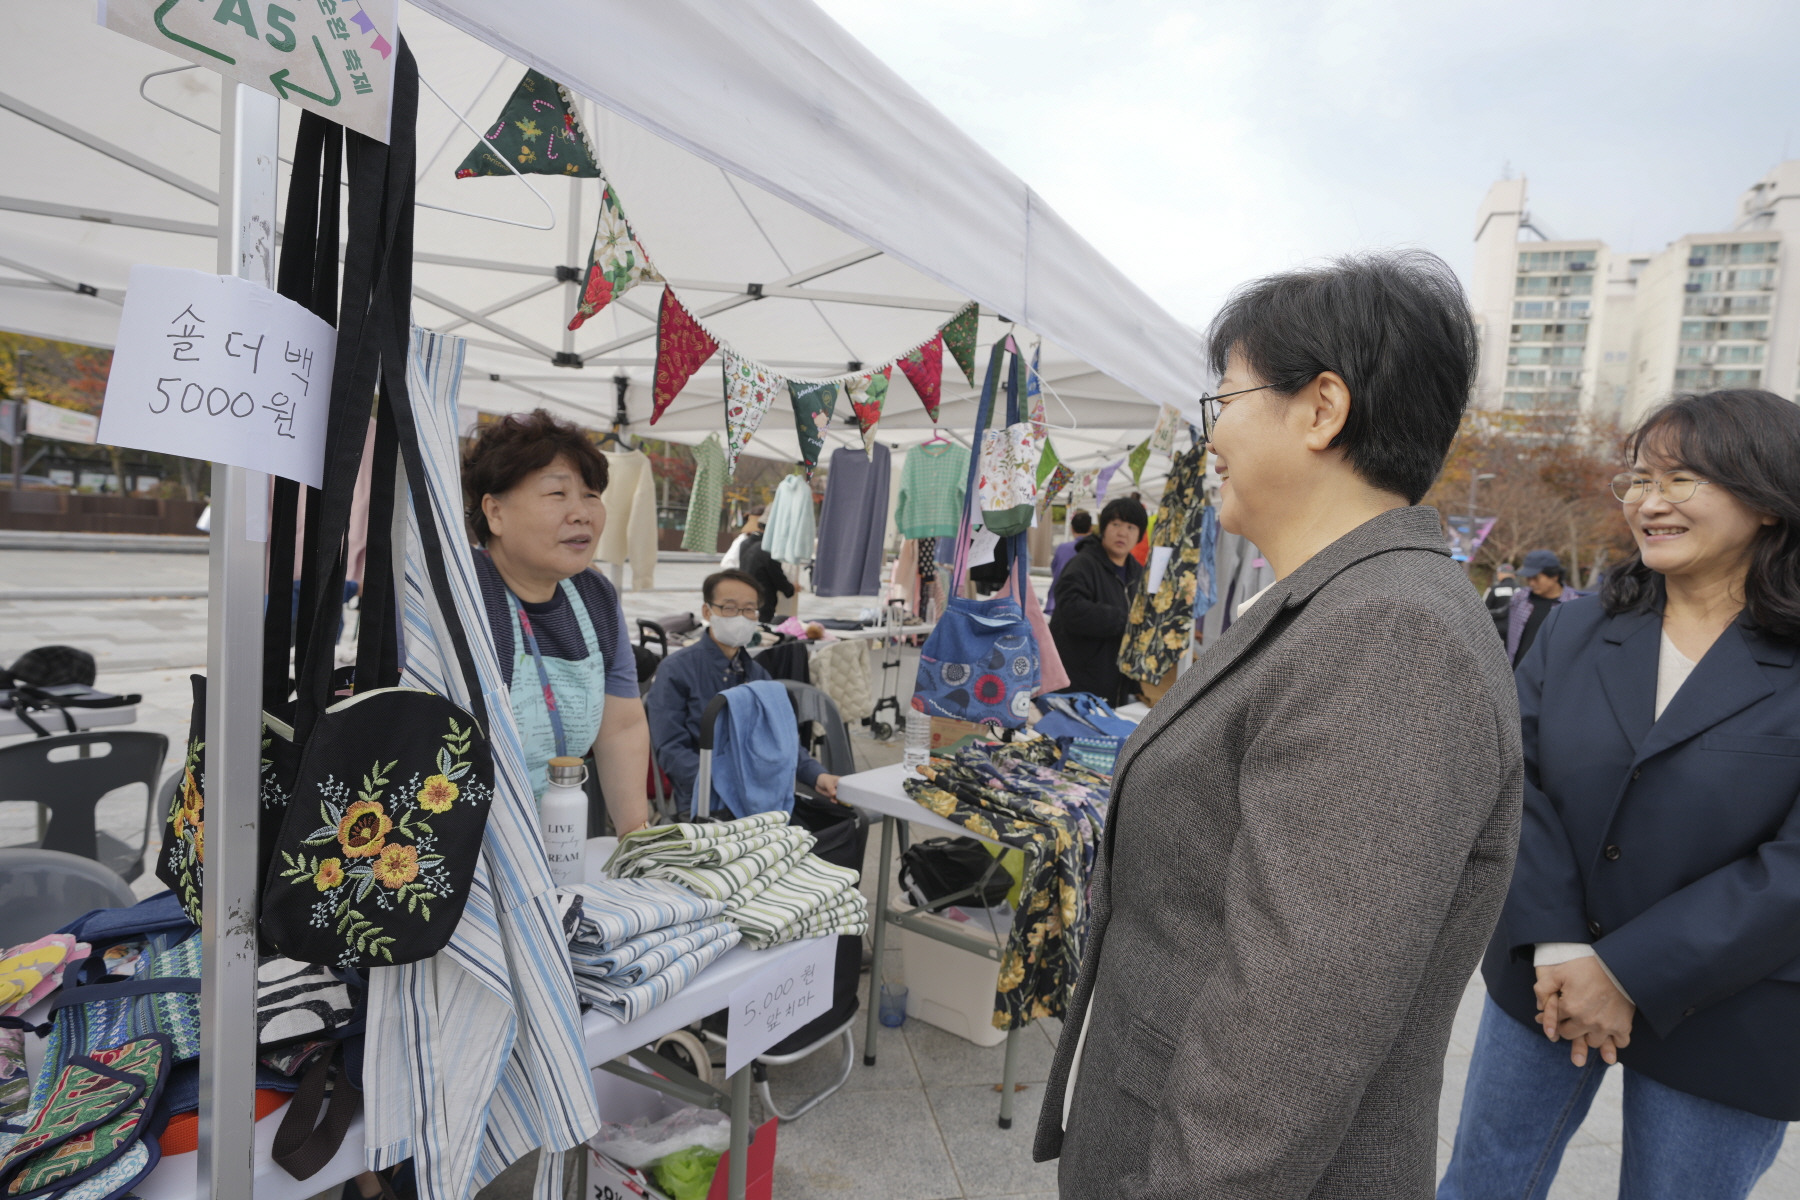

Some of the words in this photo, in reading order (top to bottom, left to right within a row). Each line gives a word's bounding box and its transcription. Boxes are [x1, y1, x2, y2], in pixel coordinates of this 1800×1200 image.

[342, 49, 374, 95] 축제
[548, 824, 574, 833] LIVE
[547, 852, 579, 862] REAM
